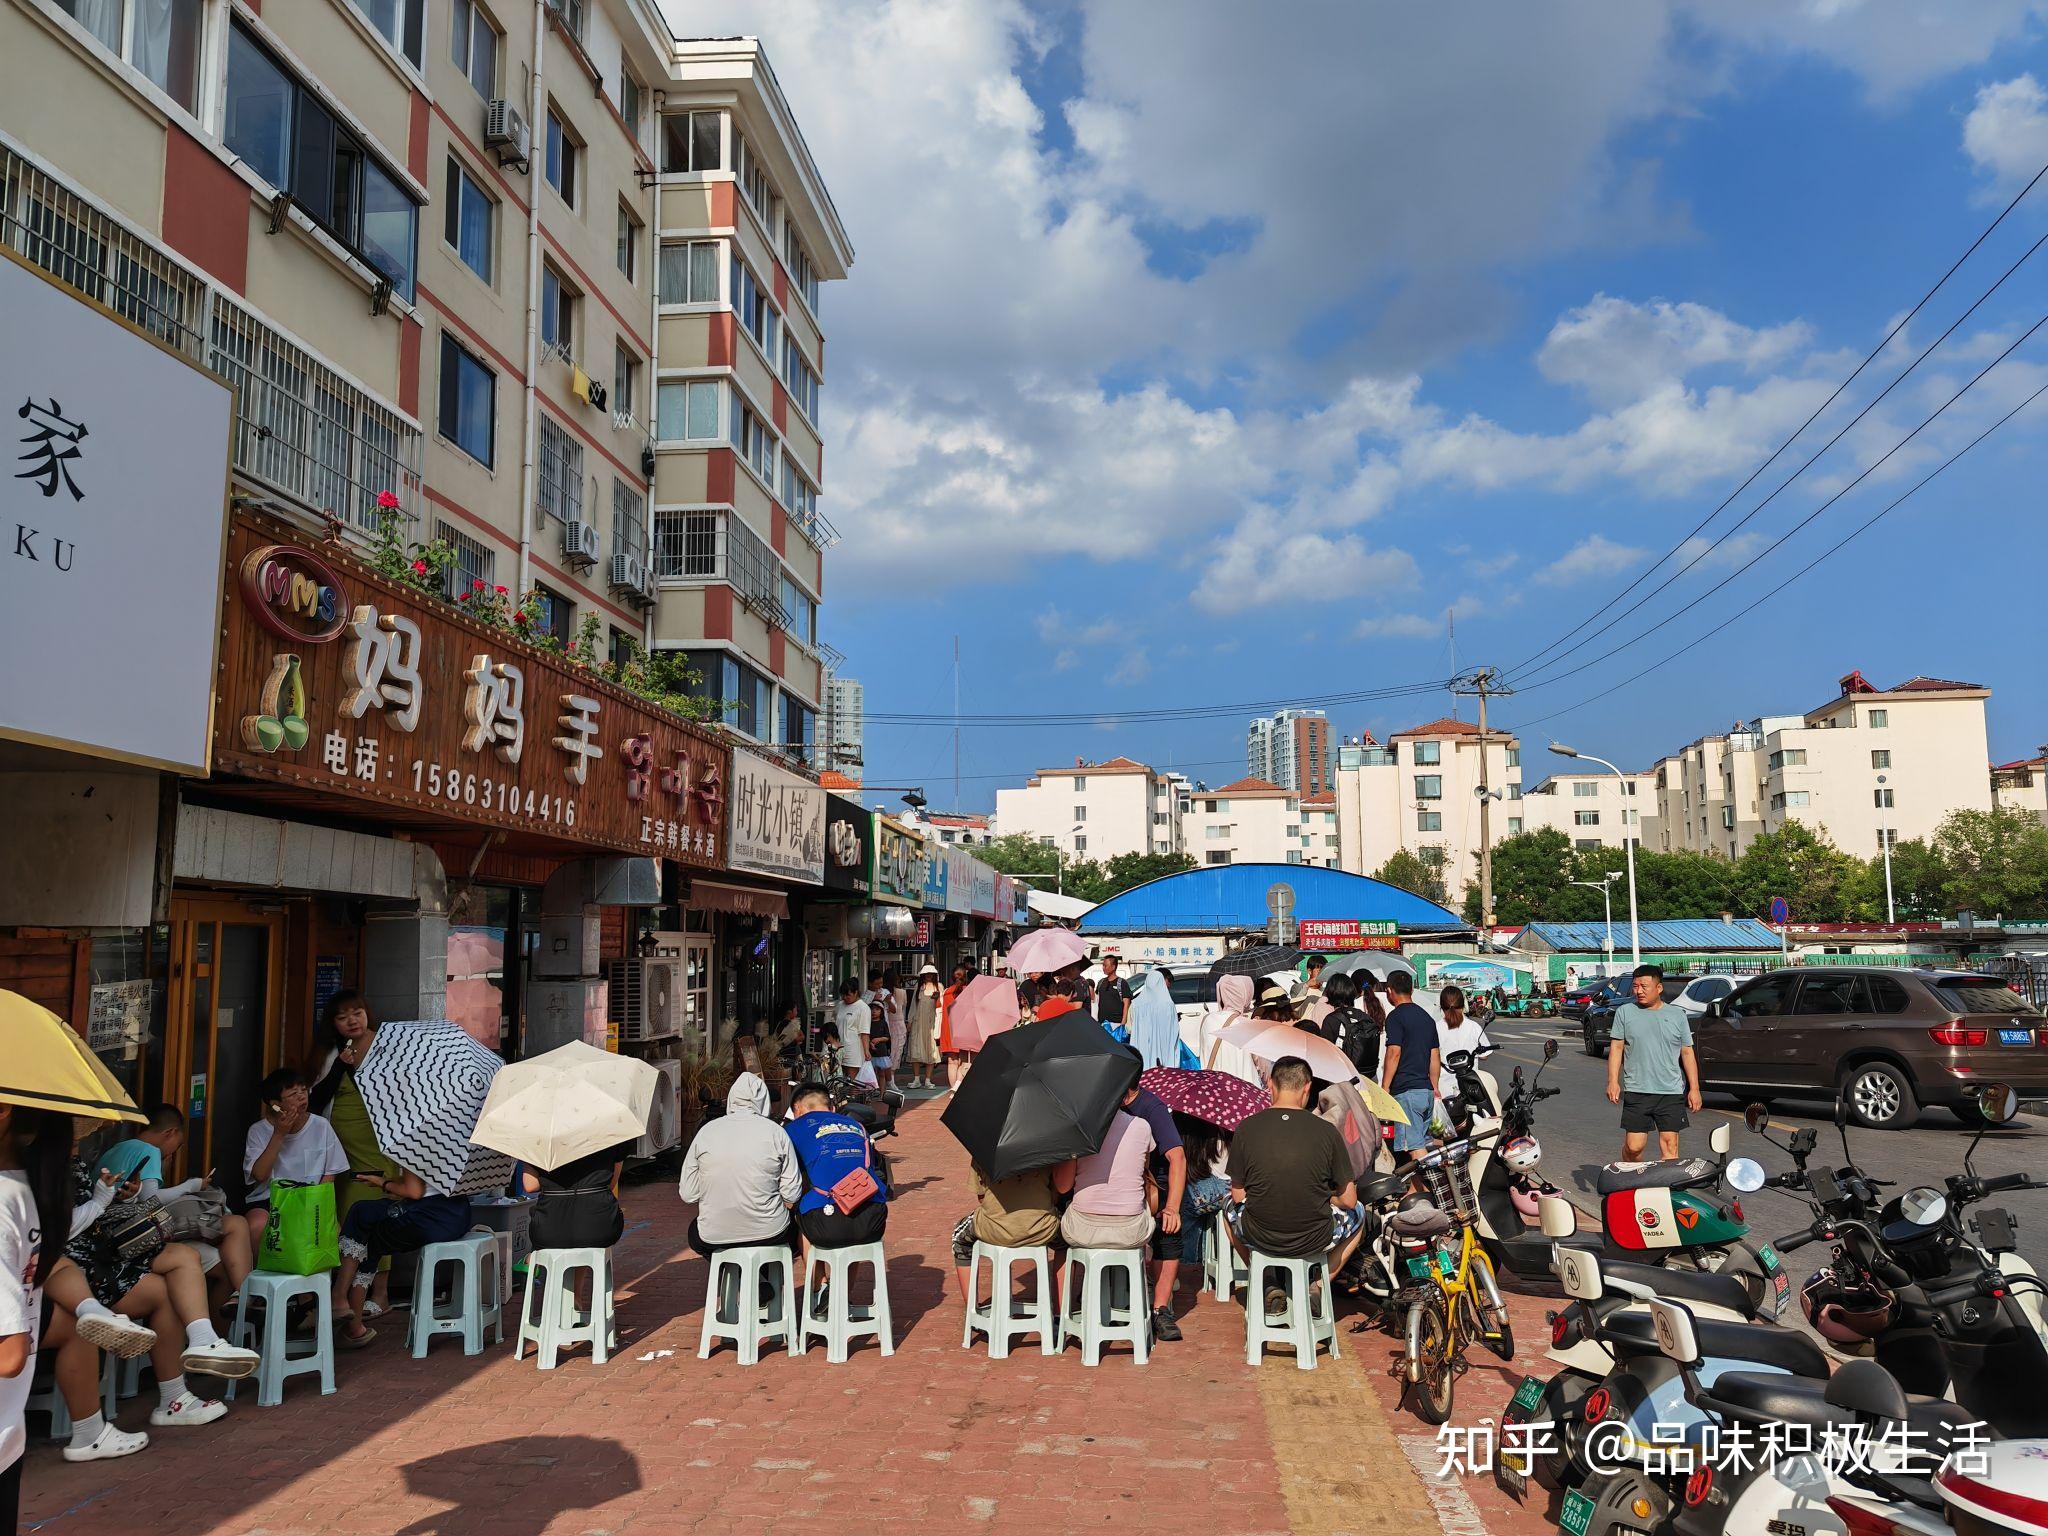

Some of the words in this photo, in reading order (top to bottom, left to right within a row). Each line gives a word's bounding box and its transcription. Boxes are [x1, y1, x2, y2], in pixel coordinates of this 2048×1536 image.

[14, 396, 89, 503] 家
[262, 560, 336, 622] MMS
[338, 604, 604, 786] 妈妈手
[411, 759, 576, 827] 15863104416
[736, 772, 805, 852] 时光小镇
[640, 815, 716, 859] 正宗韩餐米酒
[1143, 947, 1215, 957] 小船海鲜批发
[1562, 1507, 1586, 1531] 28587
